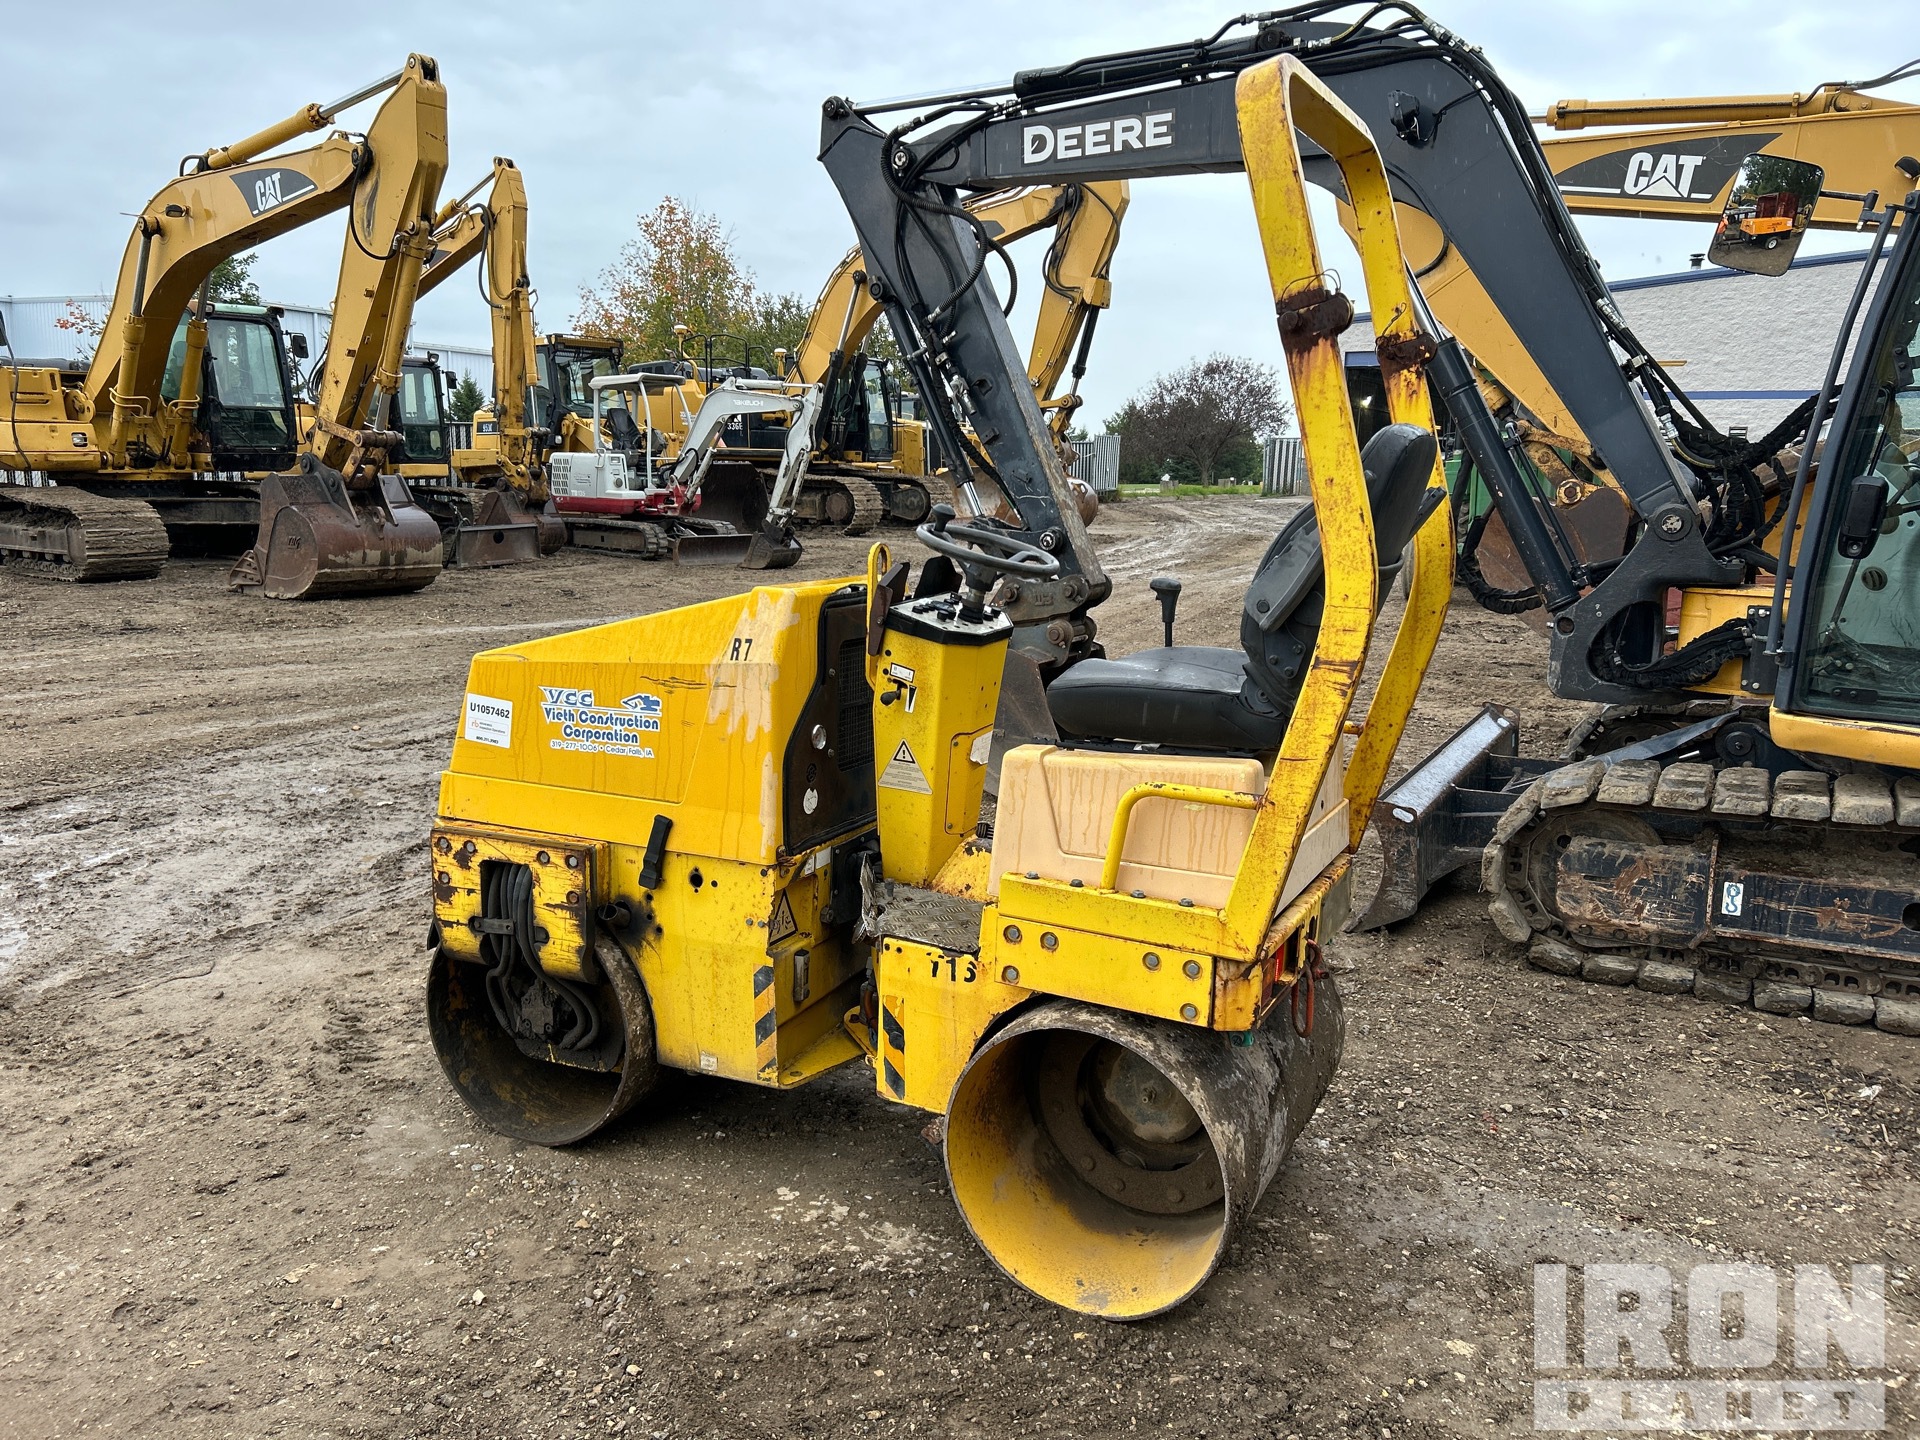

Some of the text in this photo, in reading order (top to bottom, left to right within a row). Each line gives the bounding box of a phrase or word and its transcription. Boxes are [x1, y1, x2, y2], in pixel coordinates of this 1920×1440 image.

[1023, 112, 1173, 164] DEERE
[1624, 152, 1703, 198] CAT
[255, 171, 283, 212] CAT
[730, 637, 753, 661] R7
[543, 688, 593, 708] VCC
[470, 702, 510, 719] U1057462
[544, 707, 659, 730] Vieth Construction
[563, 724, 639, 744] Corporation
[551, 741, 598, 752] 319-277-1006
[605, 745, 626, 755] Cedar
